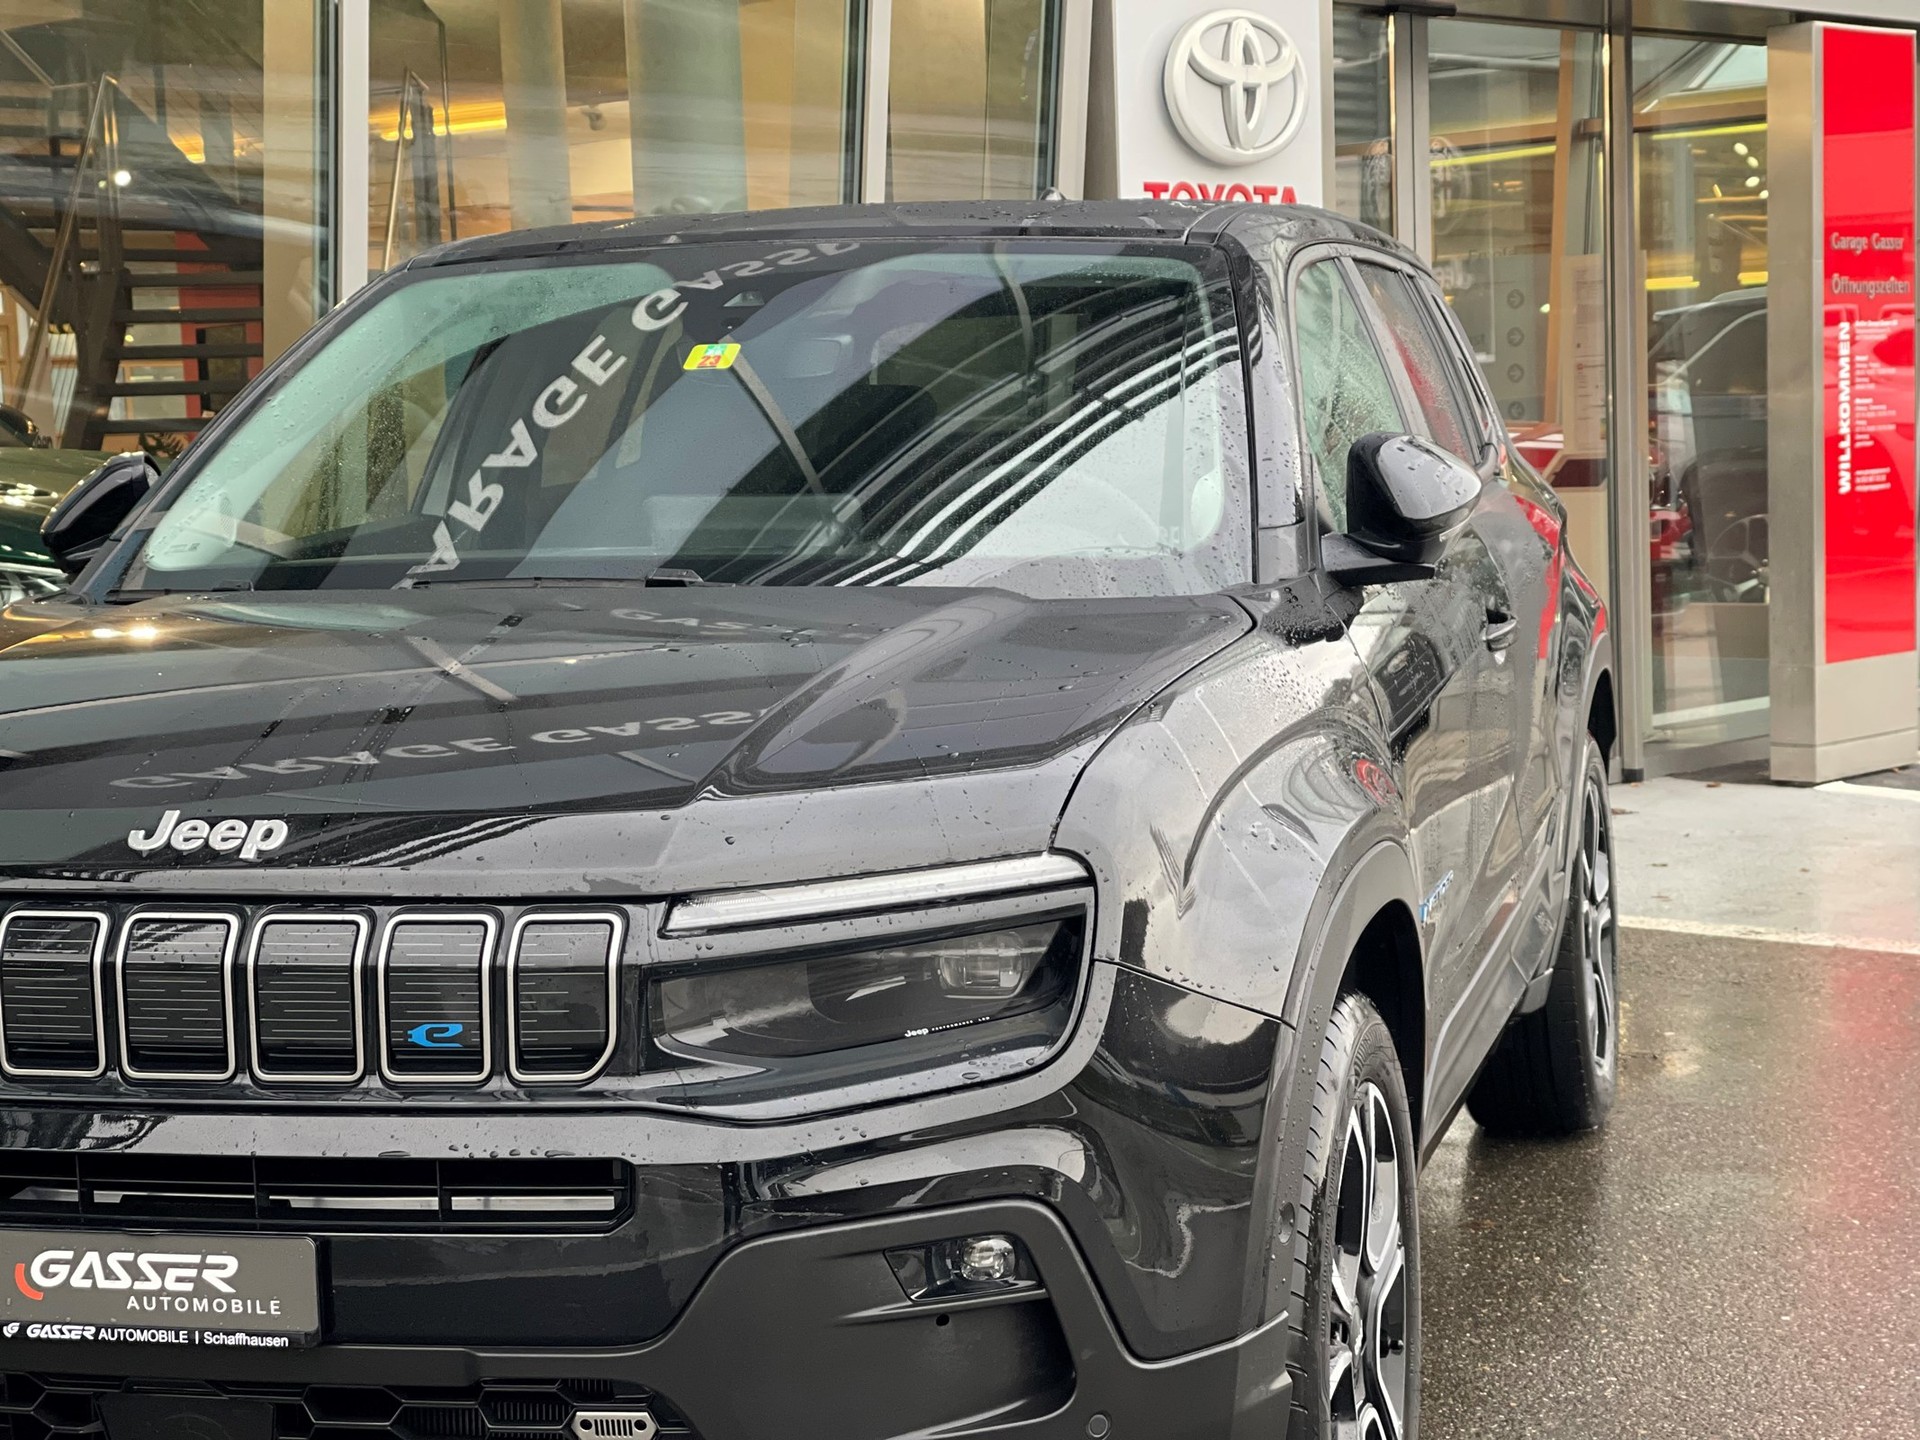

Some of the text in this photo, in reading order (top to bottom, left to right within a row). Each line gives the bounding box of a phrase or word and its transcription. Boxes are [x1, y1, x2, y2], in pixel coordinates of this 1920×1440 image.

[1831, 232, 1868, 255] Garage
[1832, 272, 1910, 299] Öffnungszeiten
[1838, 321, 1851, 494] WILLKOMMEN
[128, 810, 288, 861] Jeep
[905, 1028, 929, 1038] Jeep
[30, 1250, 239, 1292] GASSER
[127, 1296, 281, 1315] AUTOMOBILE
[26, 1323, 96, 1339] GASSER
[98, 1327, 188, 1343] AUTOMOBILE
[203, 1332, 289, 1347] Schaffhausen
